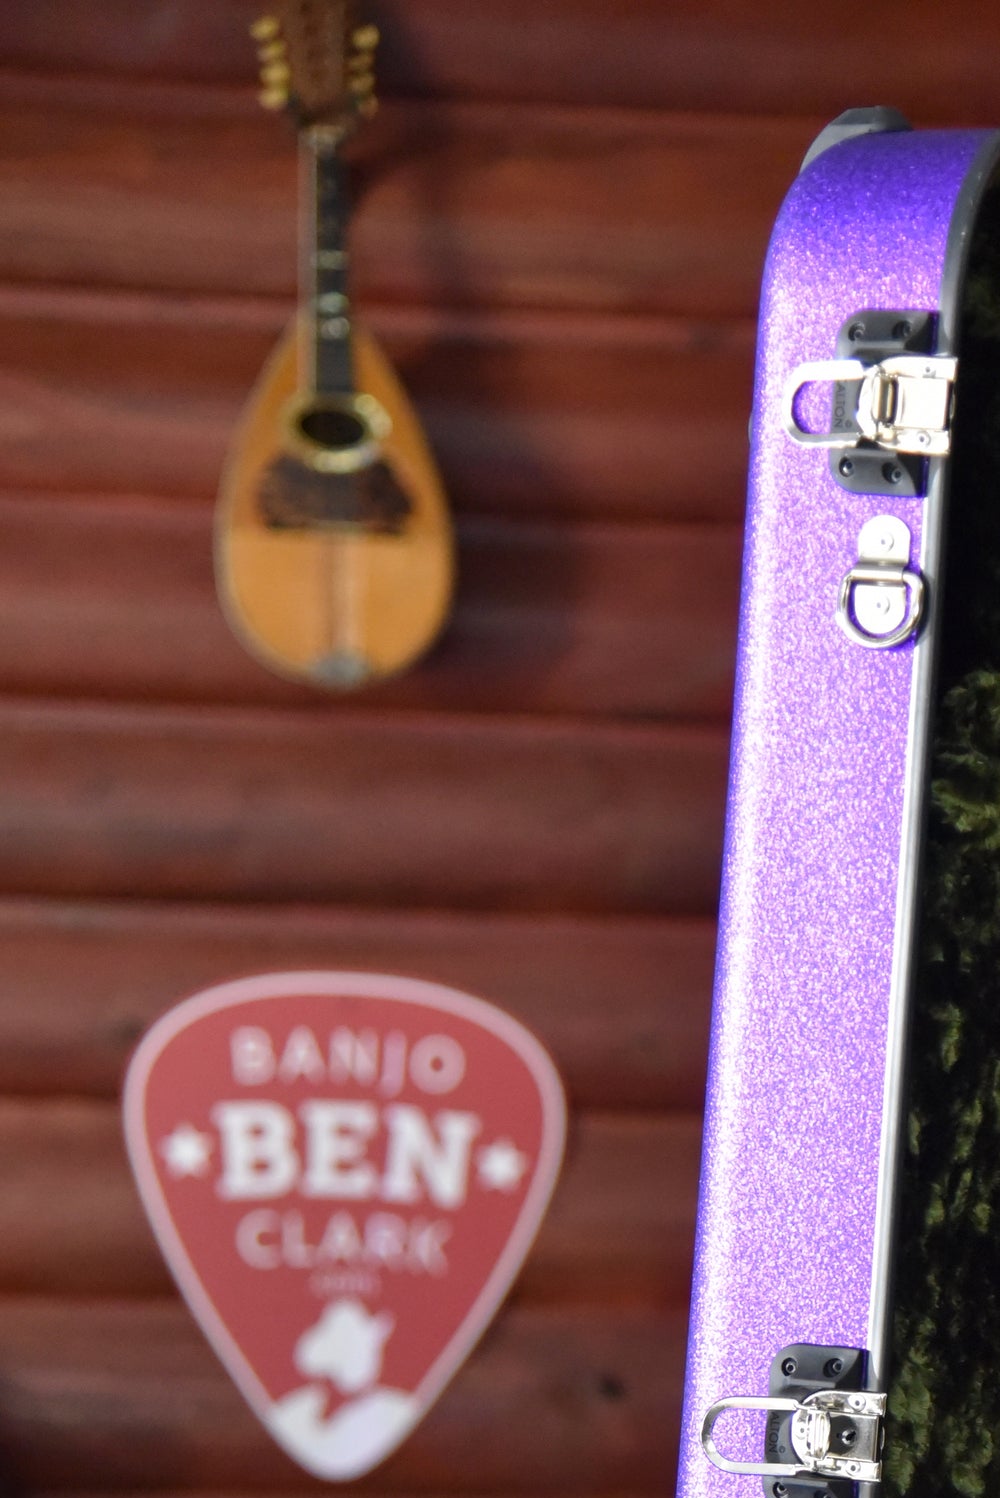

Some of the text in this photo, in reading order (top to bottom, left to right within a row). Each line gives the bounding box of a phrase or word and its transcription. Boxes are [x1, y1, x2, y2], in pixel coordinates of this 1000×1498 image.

[834, 381, 845, 428] ALTON
[231, 1026, 466, 1096] BANJO
[212, 1099, 480, 1208] BEN
[236, 1208, 450, 1273] CLARK
[768, 1411, 779, 1454] ALTON
